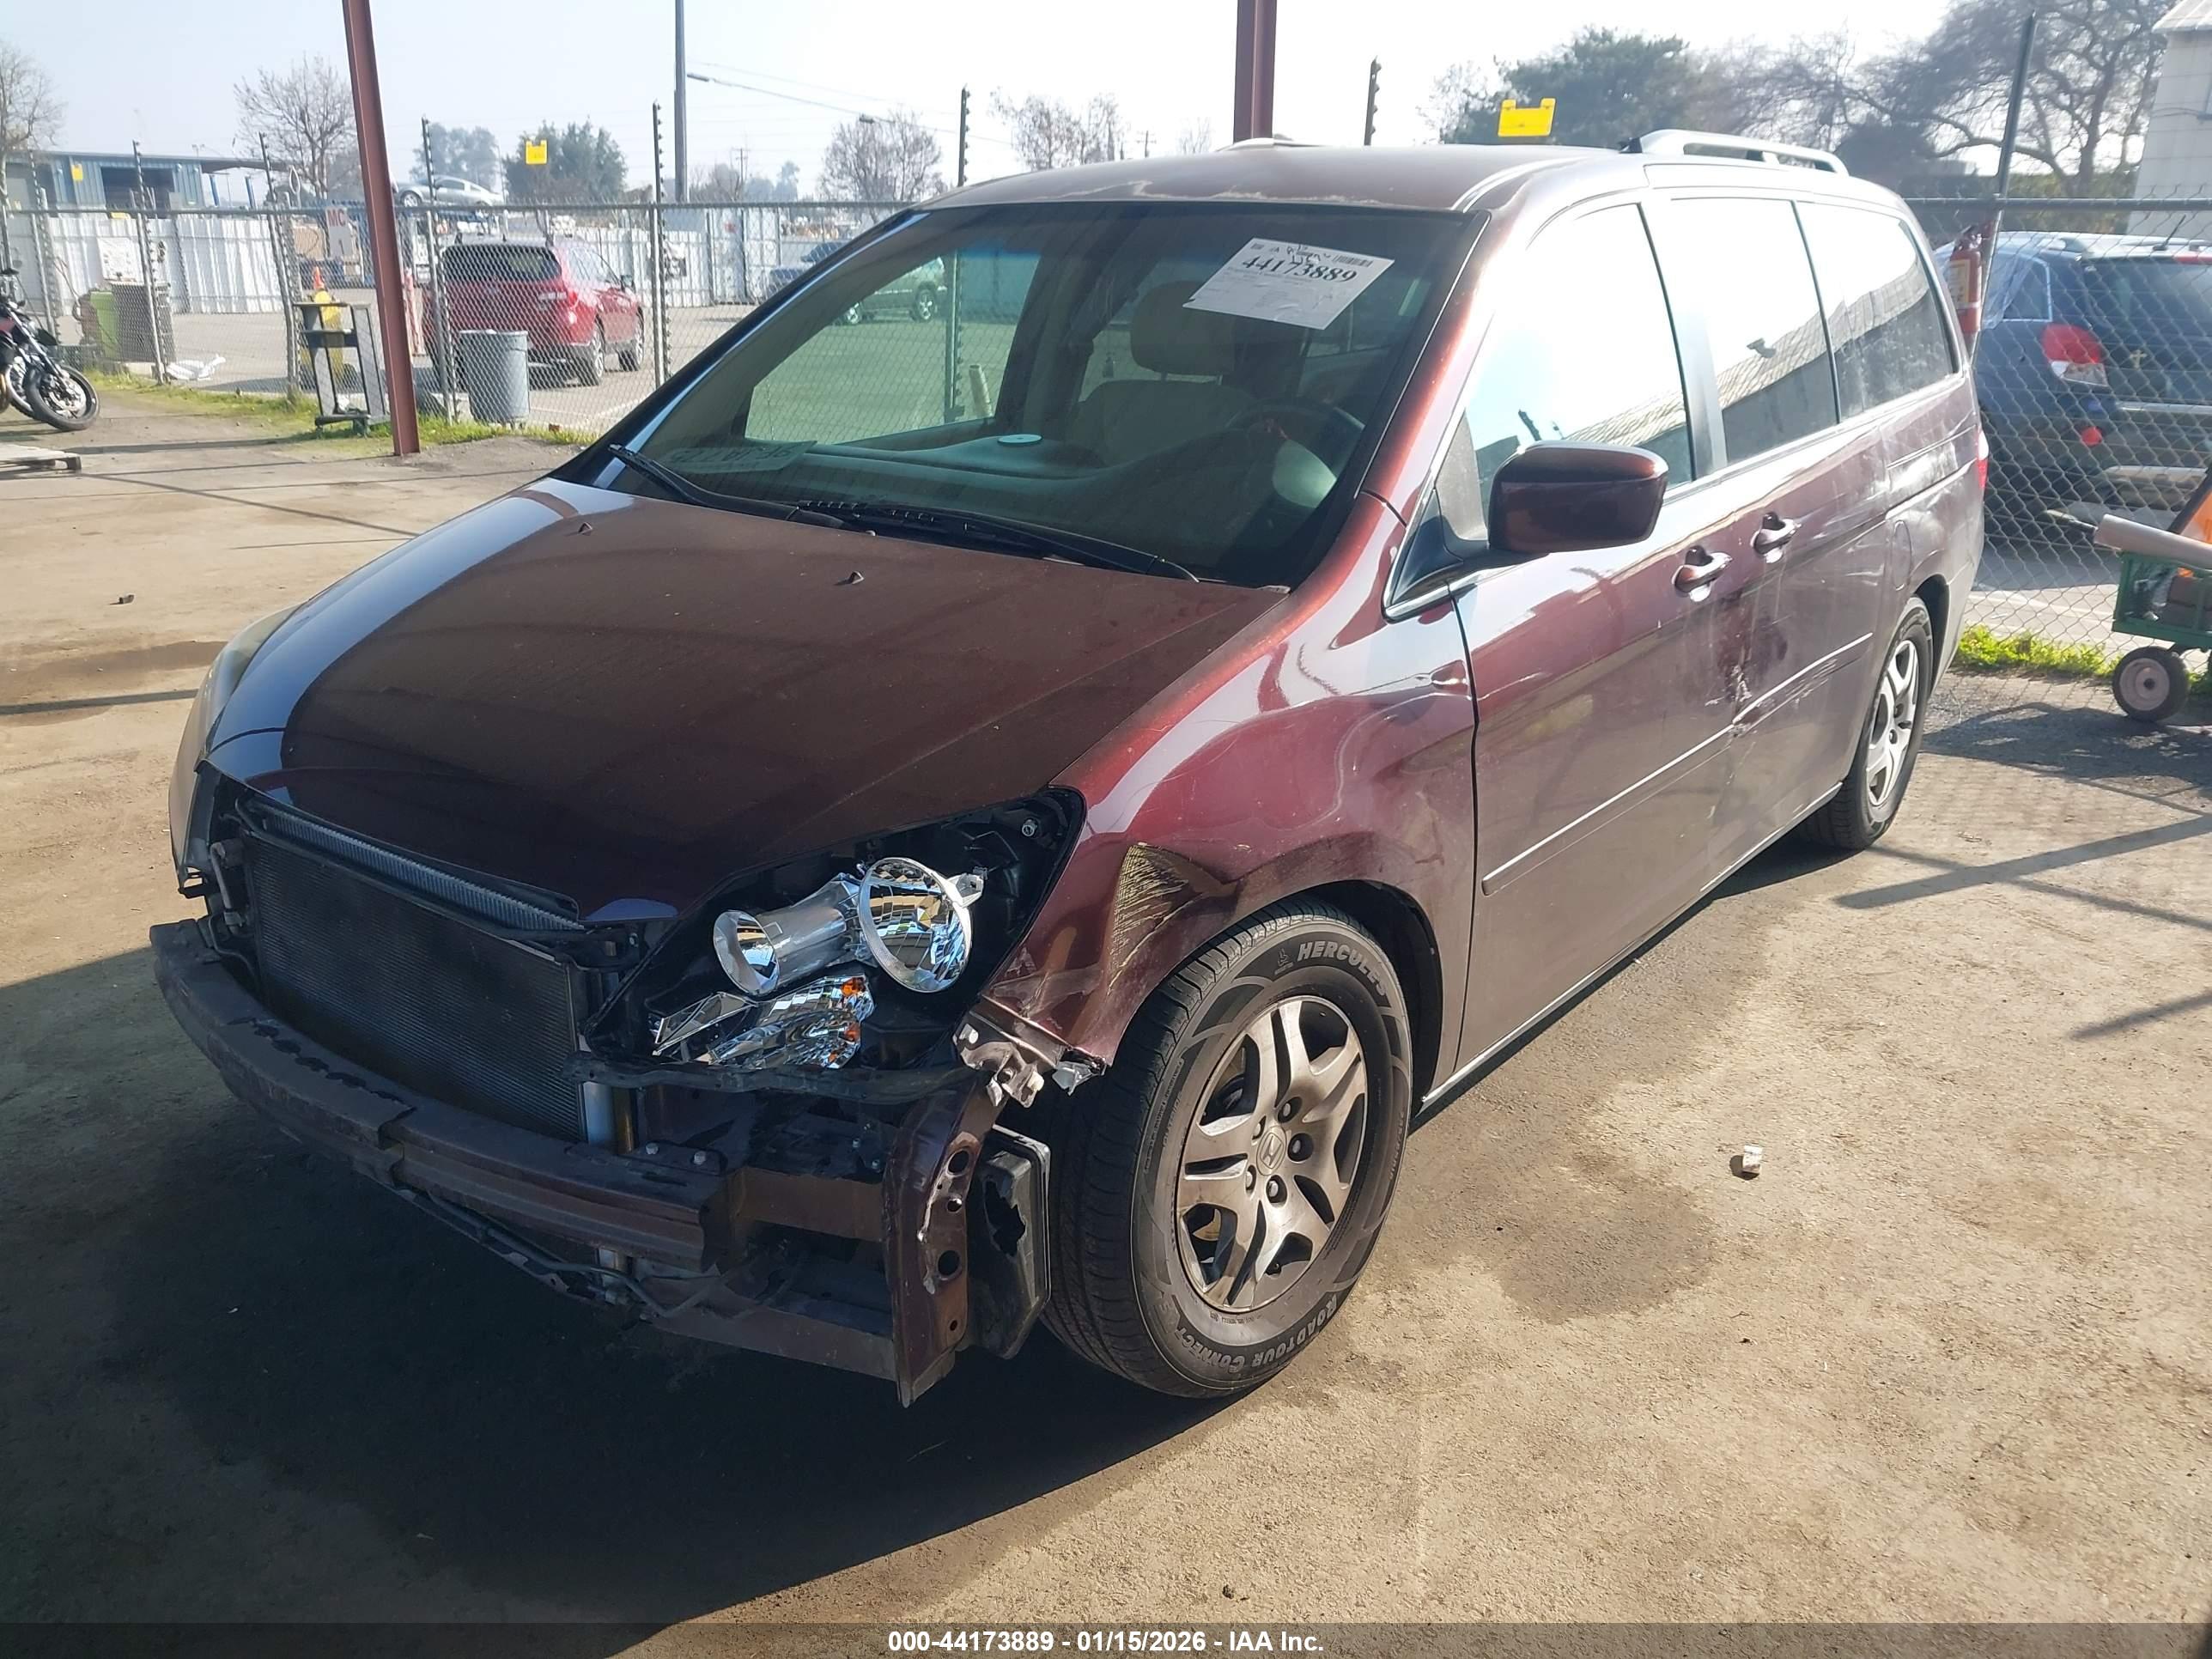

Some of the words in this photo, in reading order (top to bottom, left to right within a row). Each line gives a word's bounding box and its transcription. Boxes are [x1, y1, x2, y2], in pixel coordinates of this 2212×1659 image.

[327, 209, 346, 227] MC
[1243, 256, 1358, 283] 44173889
[1297, 940, 1388, 996] HERCULES
[1176, 1327, 1245, 1374] CONNECT
[1251, 1294, 1338, 1367] ROADTOUR
